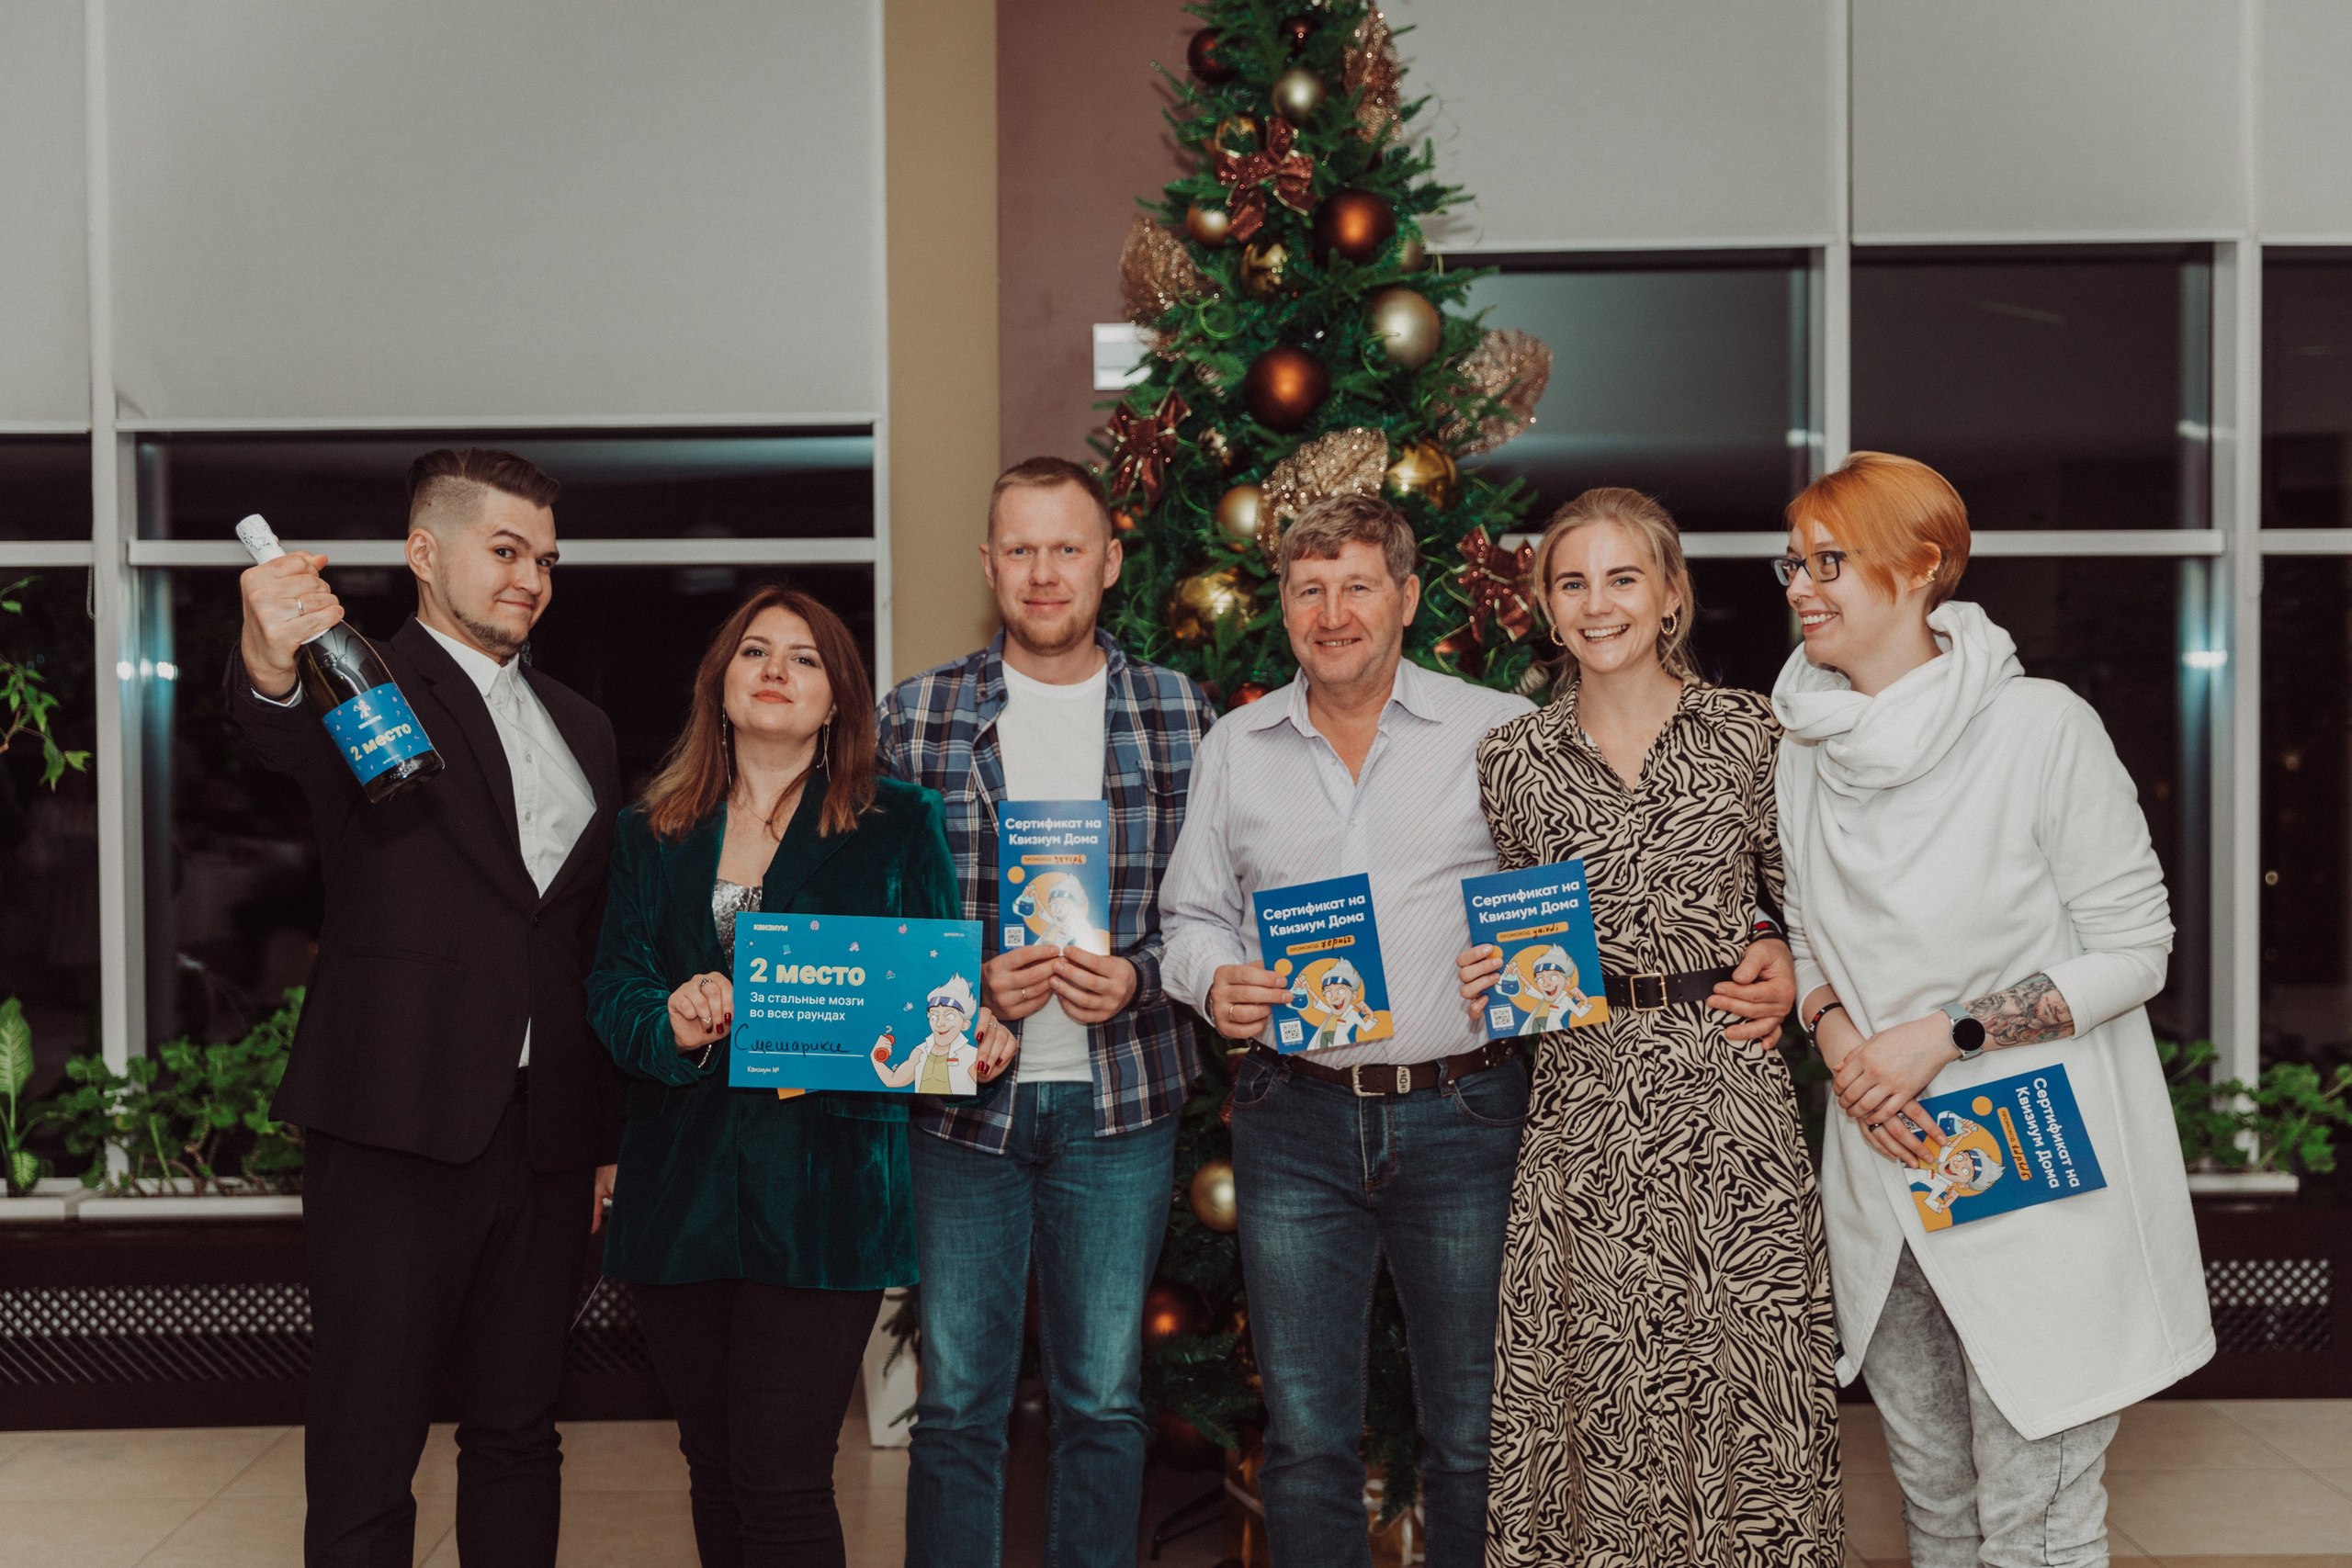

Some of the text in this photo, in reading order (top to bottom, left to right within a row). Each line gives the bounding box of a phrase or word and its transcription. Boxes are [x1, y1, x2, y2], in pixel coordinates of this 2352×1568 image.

[350, 746, 363, 761] 2
[361, 723, 412, 754] место
[1005, 818, 1102, 831] Сертификат на
[1009, 833, 1098, 847] Квизиум Дома
[1262, 894, 1366, 921] Сертификат на
[1472, 881, 1580, 908] Сертификат на
[1479, 898, 1578, 924] Квизиум Дома
[1270, 912, 1365, 937] Квизиум Дома
[1499, 931, 1531, 939] ПРОМОКОД
[1289, 942, 1319, 953] ПРОМОКОД
[750, 957, 866, 987] 2 место
[750, 992, 864, 1006] За стальные мозги
[750, 1010, 845, 1022] во всех раундах
[734, 1023, 850, 1057] Смешарики
[747, 1066, 771, 1075] Квизиум
[2001, 1110, 2016, 1143] ПРОМОКОД
[2015, 1086, 2060, 1189] Квизиум Дома
[2033, 1077, 2080, 1188] Сертификат на
